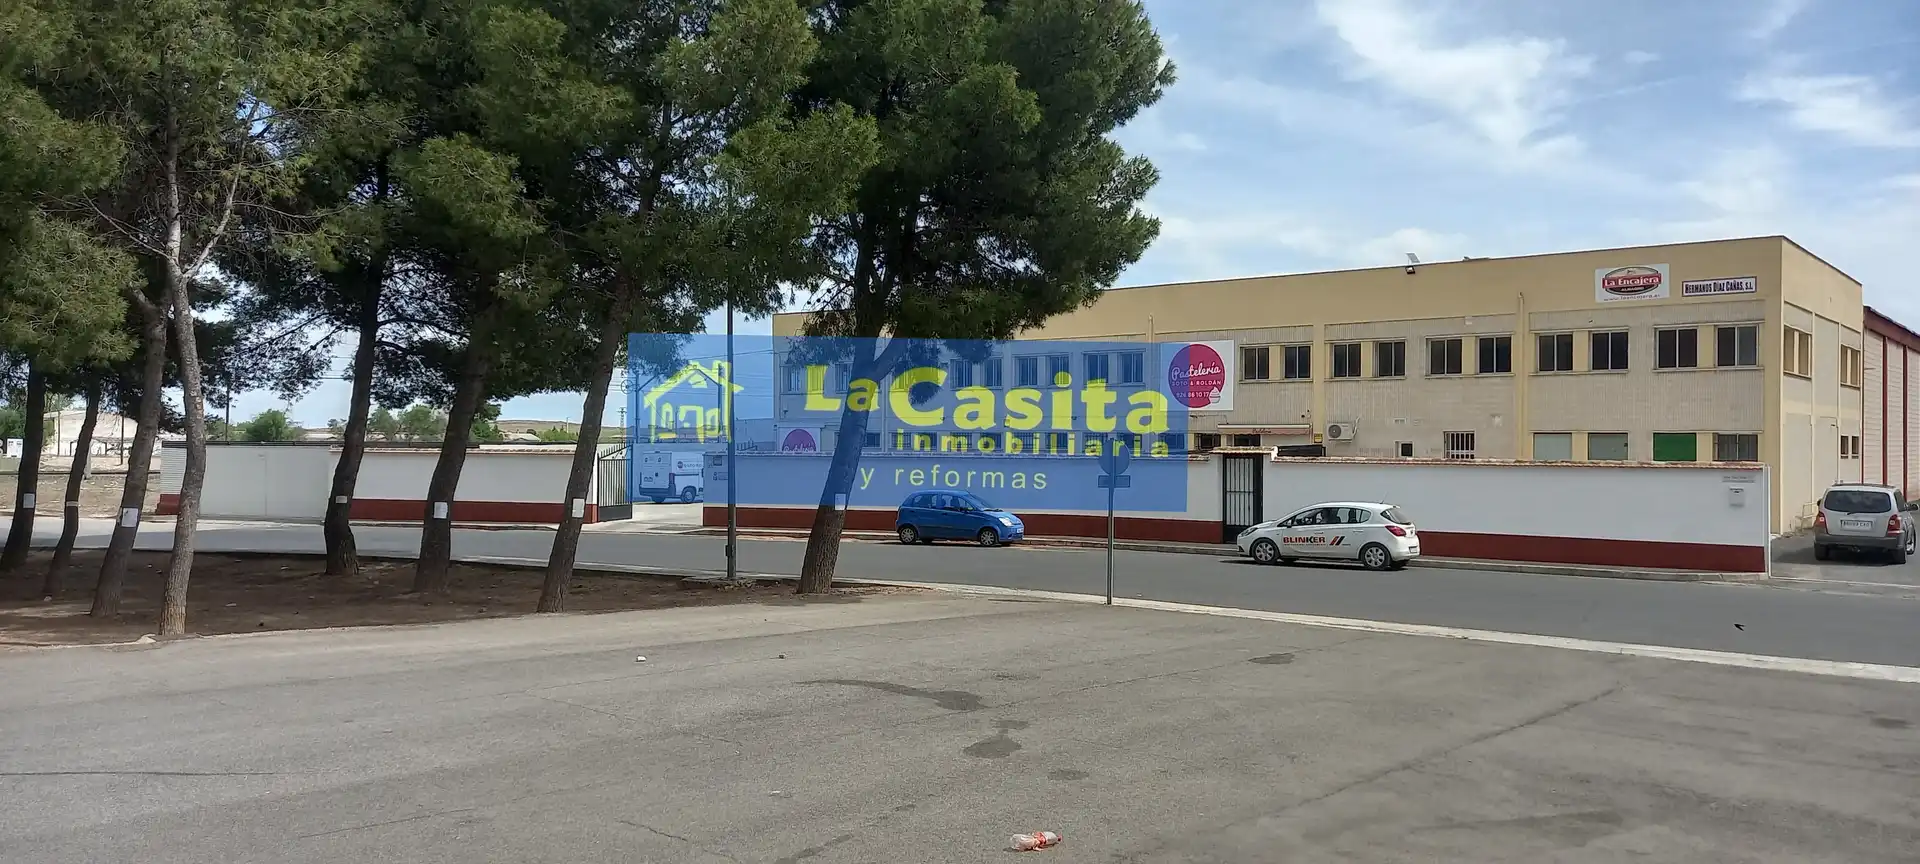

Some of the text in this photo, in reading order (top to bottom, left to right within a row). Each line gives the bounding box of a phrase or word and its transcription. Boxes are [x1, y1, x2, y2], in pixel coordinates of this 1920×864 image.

[1604, 276, 1659, 287] La Encajera
[1684, 283, 1712, 294] HERMANOS
[1171, 362, 1221, 381] Pastelería
[1283, 536, 1326, 544] BLINKER
